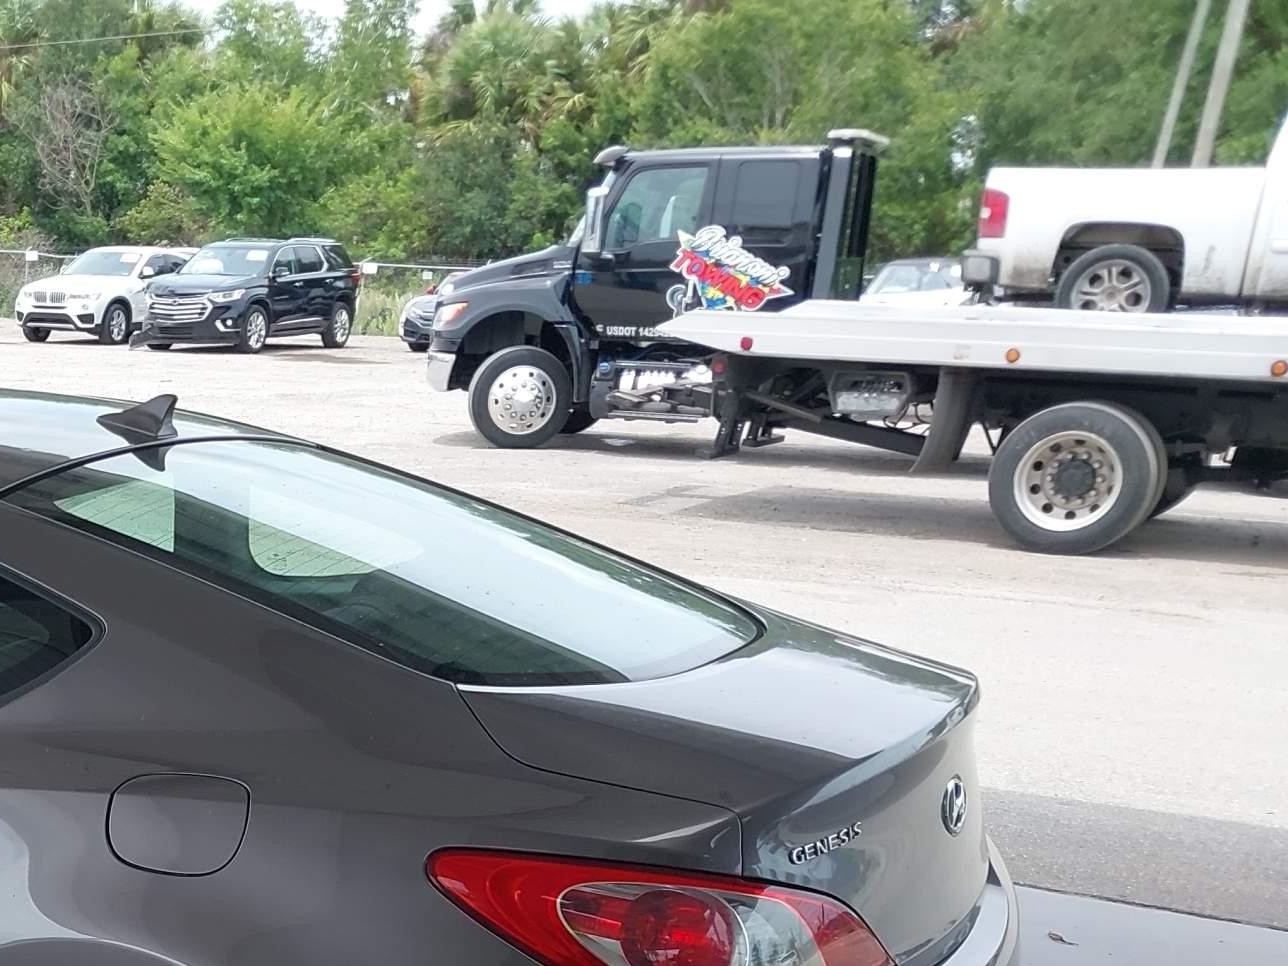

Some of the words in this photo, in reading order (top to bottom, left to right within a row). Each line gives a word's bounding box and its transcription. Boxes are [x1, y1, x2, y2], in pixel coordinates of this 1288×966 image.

[673, 248, 766, 309] TOWING
[606, 326, 637, 336] USDOT
[790, 821, 863, 865] GENESIS
